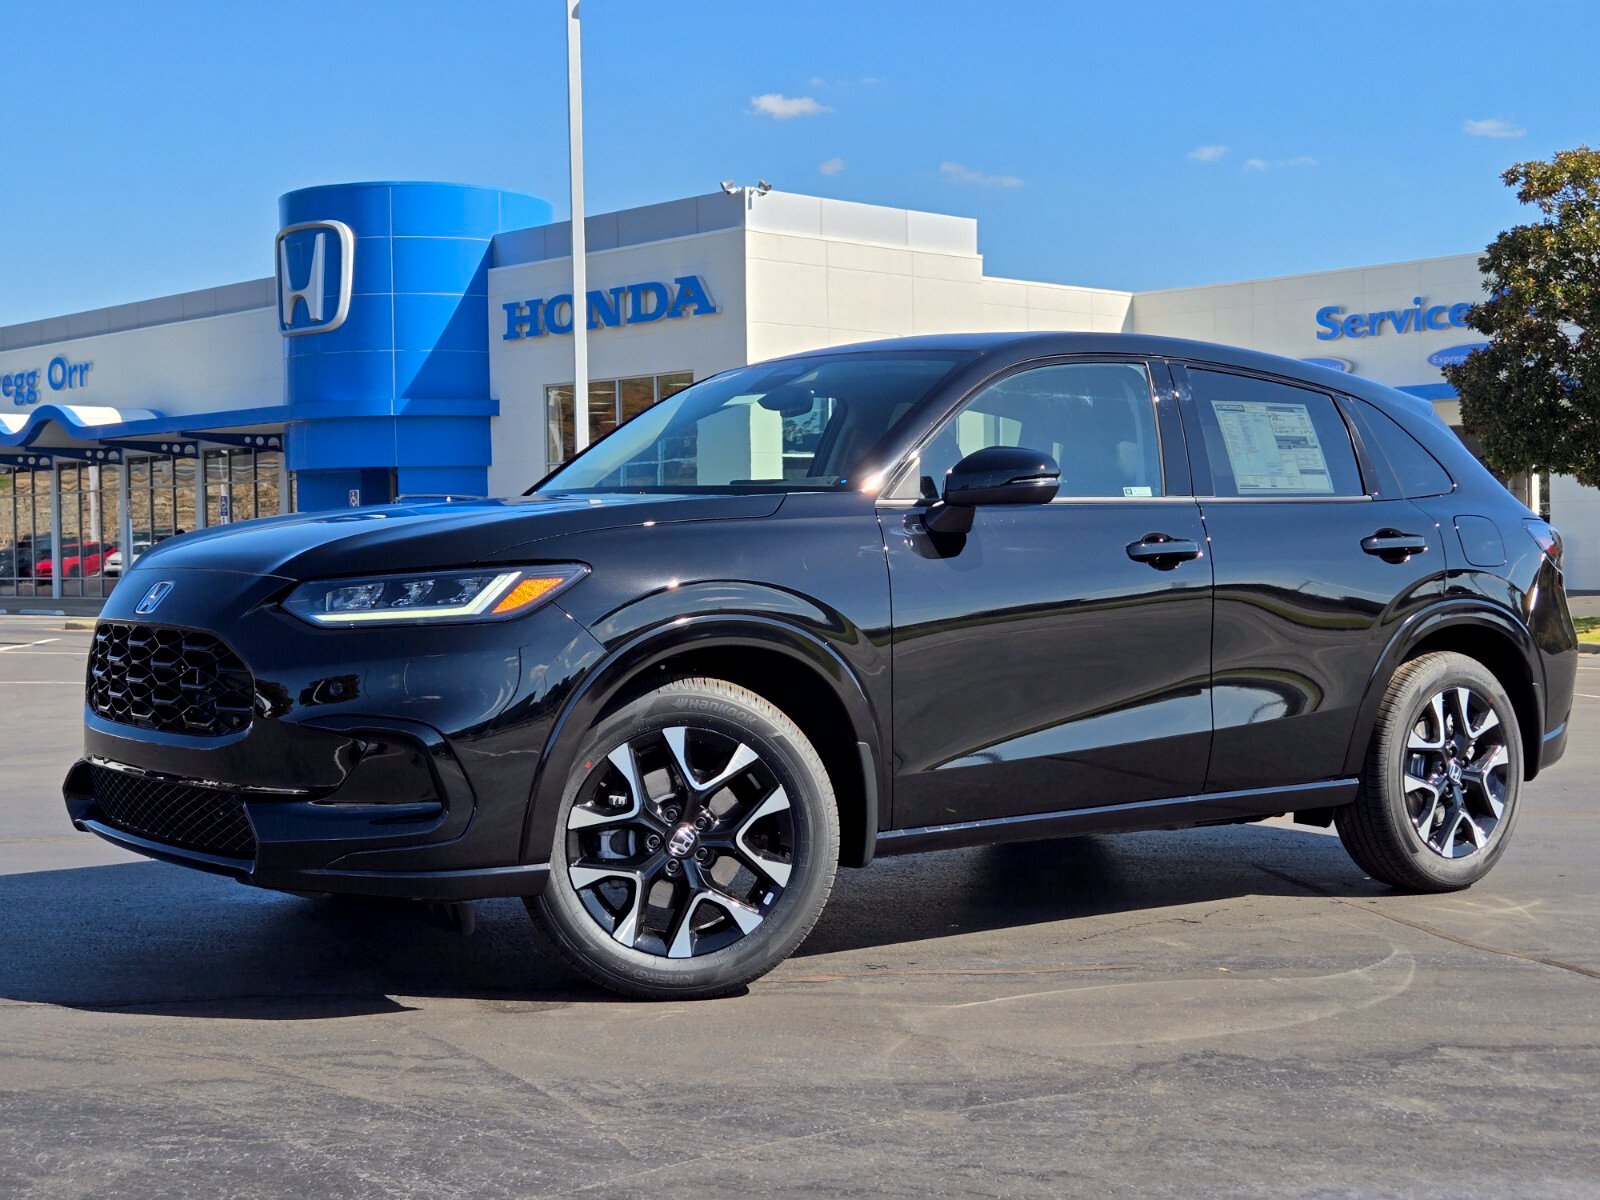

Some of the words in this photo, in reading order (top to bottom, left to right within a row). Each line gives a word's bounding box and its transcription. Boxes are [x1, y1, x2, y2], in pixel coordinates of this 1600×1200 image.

[503, 275, 718, 341] HONDA
[1316, 296, 1470, 341] Service
[0, 370, 38, 406] egg
[47, 356, 90, 391] Orr
